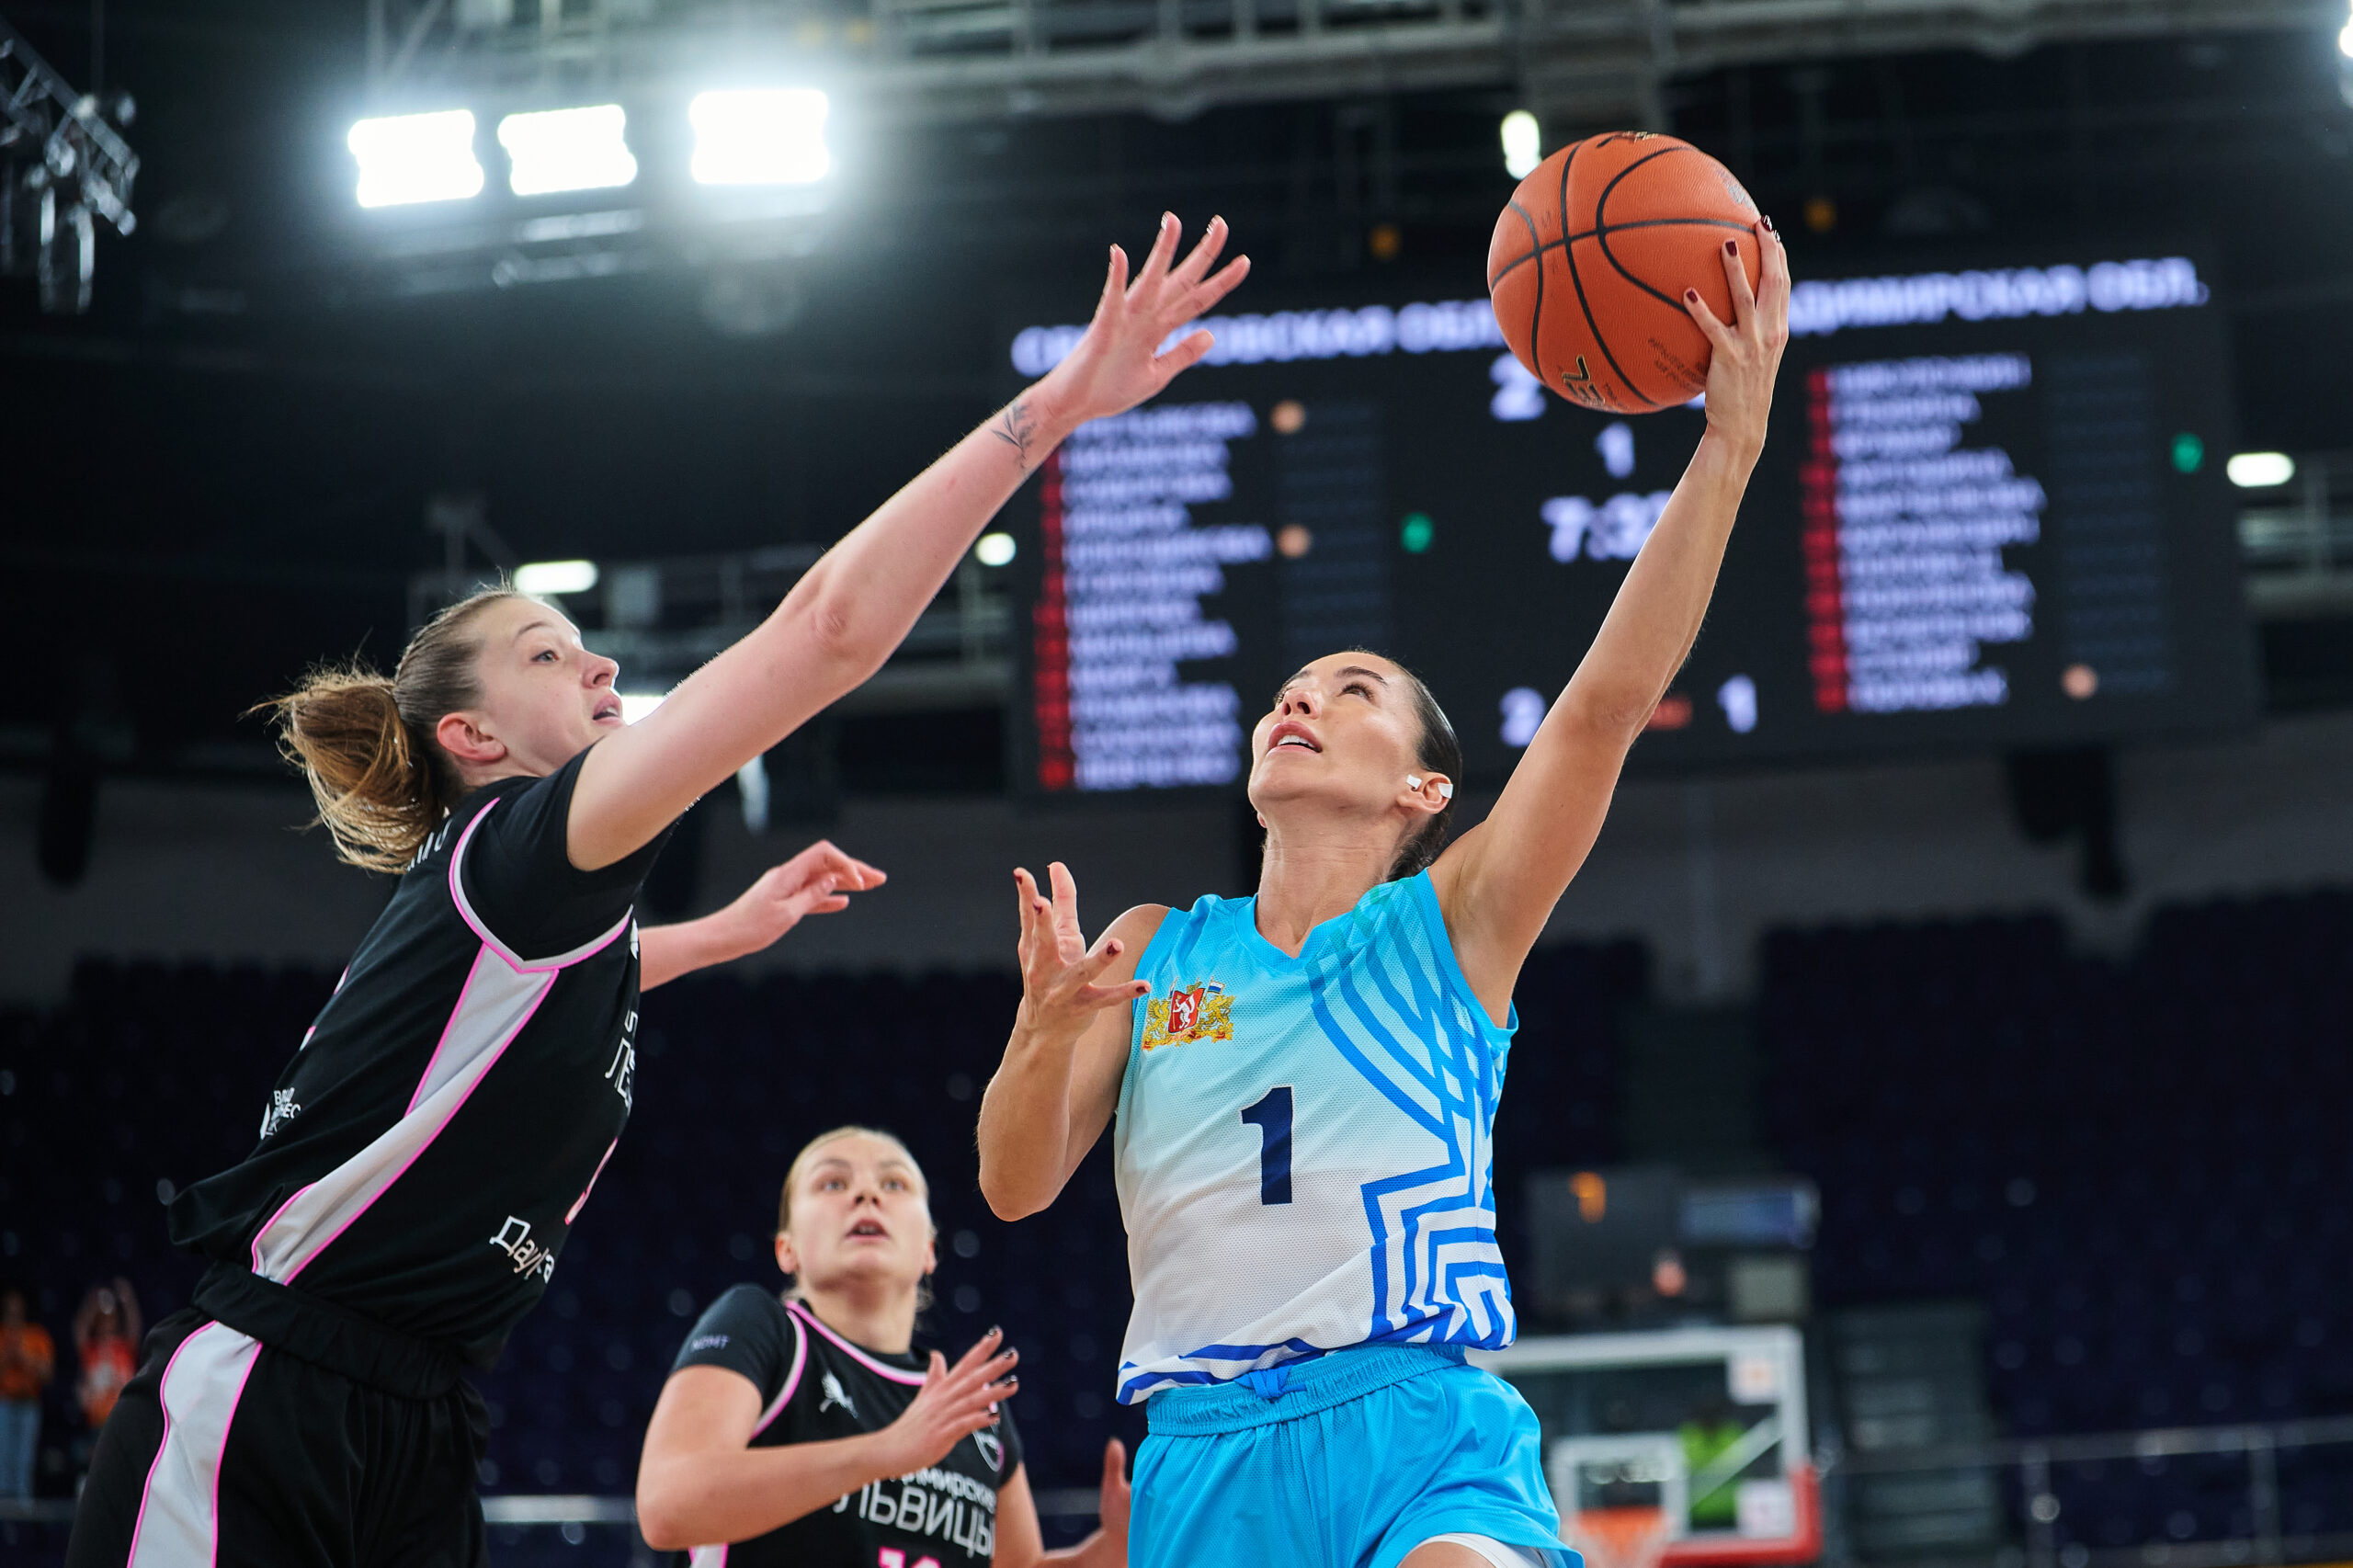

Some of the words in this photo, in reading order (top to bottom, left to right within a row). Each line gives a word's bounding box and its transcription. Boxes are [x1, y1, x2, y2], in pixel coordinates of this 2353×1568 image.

[1596, 422, 1635, 479] 1
[1717, 675, 1757, 733] 1
[1239, 1085, 1293, 1206] 1
